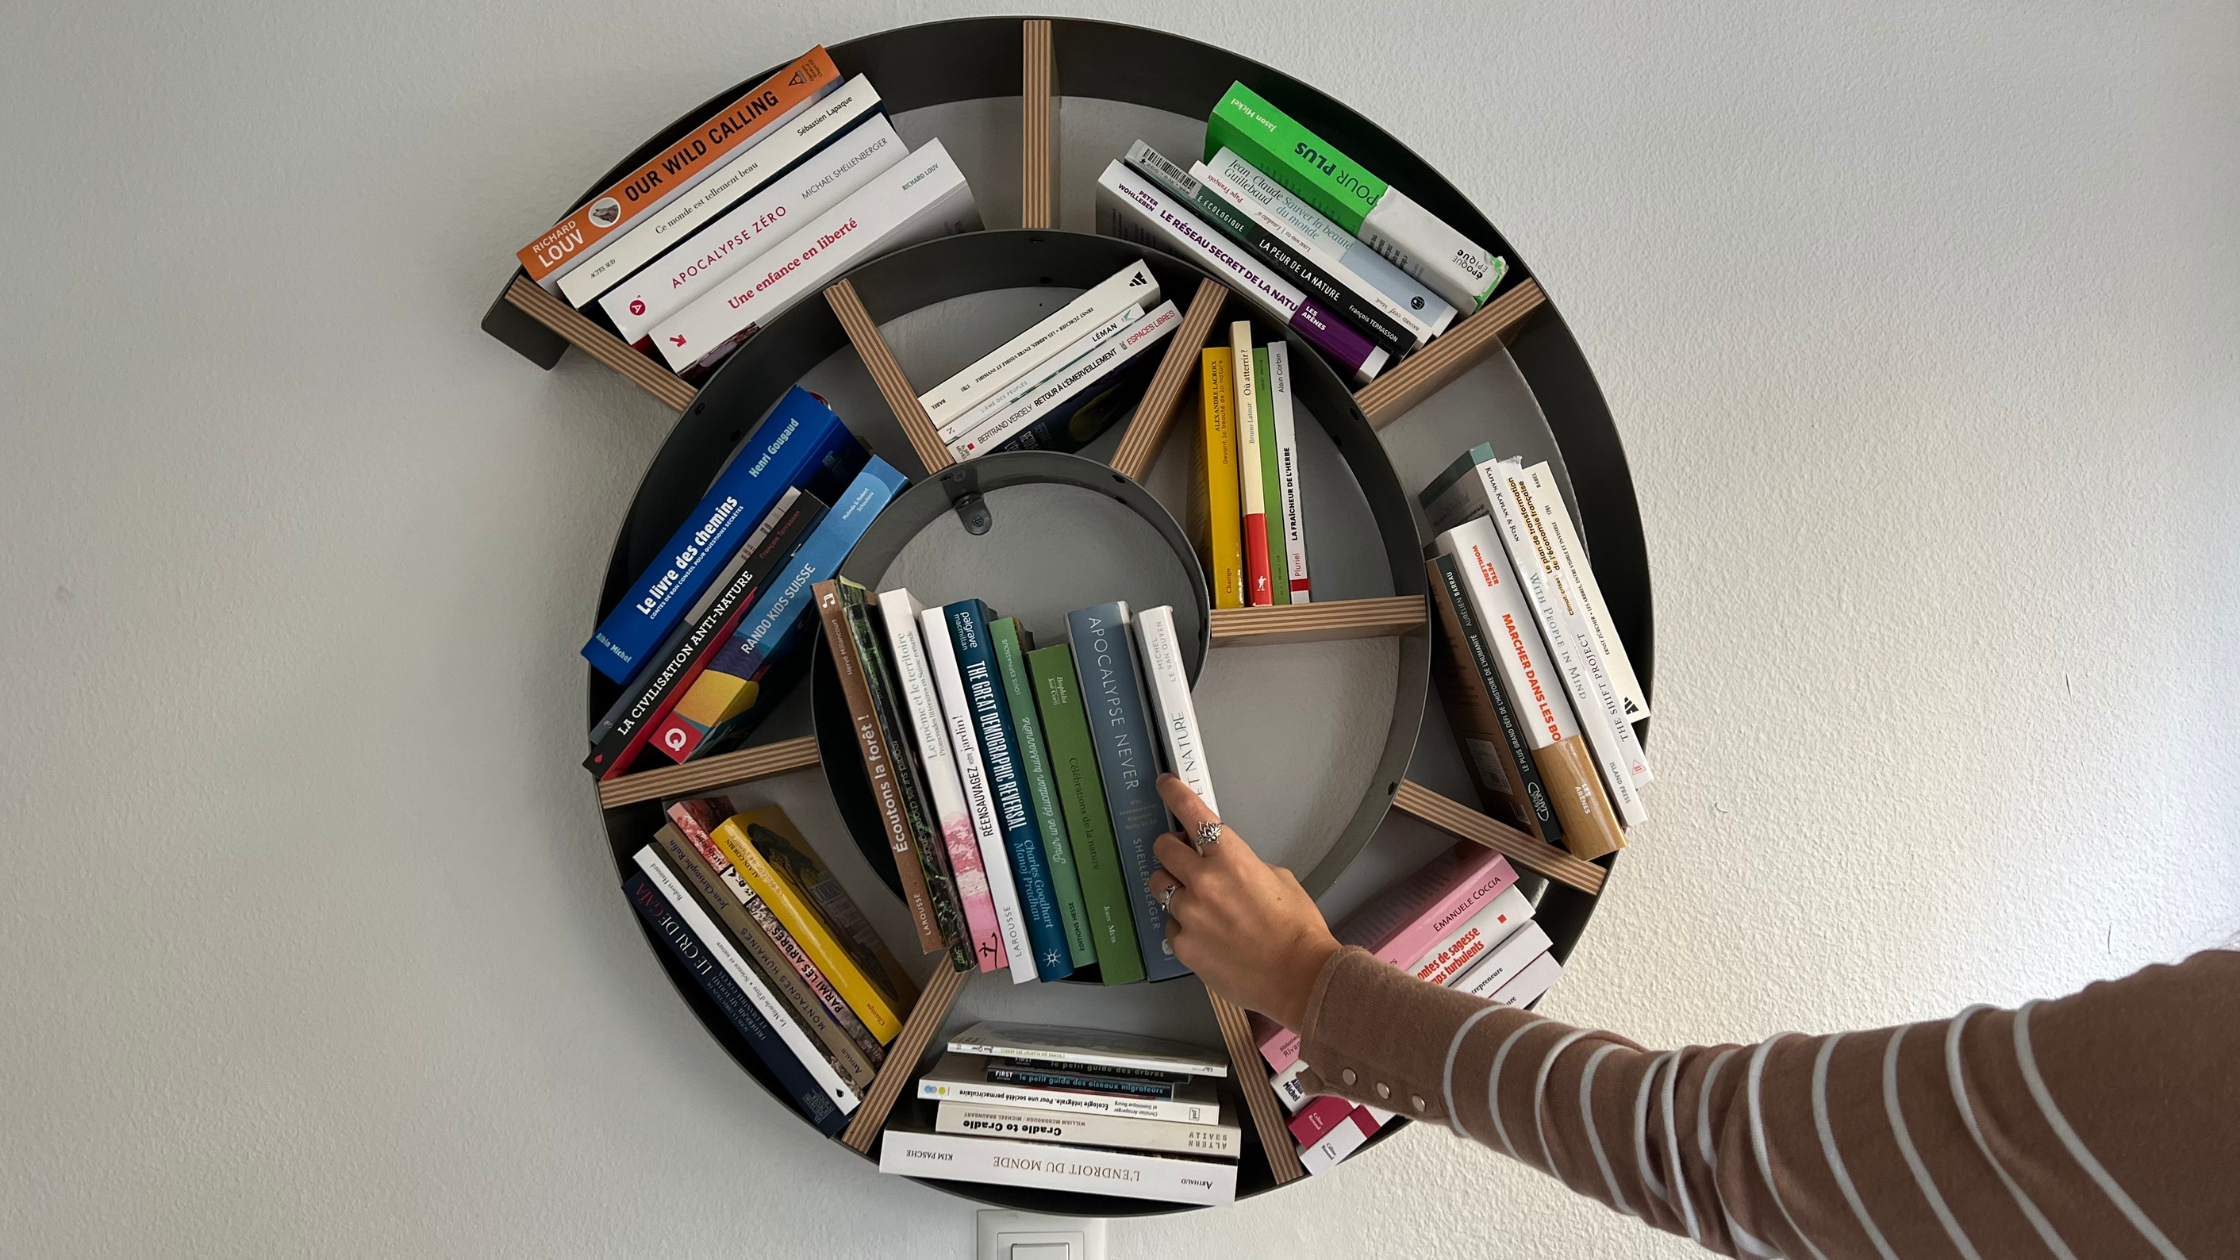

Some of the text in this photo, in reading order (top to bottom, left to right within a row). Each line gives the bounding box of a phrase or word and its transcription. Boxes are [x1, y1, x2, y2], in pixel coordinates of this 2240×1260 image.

[796, 96, 853, 137] Sébastien Lapaque
[1230, 98, 1278, 133] Jason Hickel
[624, 90, 779, 202] OUR WILD CALLING
[1294, 141, 1337, 177] PLUS
[655, 162, 759, 234] Ce monde est tellement beau
[1224, 165, 1274, 206] Guillebaud
[1228, 159, 1284, 201] Jean-Claude
[1336, 169, 1380, 206] POUR
[532, 220, 576, 254] RICHARD
[1275, 206, 1320, 240] du monde
[1281, 196, 1356, 251] Sauver la beauté
[538, 228, 584, 268] LOUV
[672, 206, 787, 289] APOCALYPSE ZÉRO
[727, 217, 858, 309] Une enfance en liberté
[1159, 209, 1174, 223] LE
[1171, 218, 1211, 249] RÉSEAU
[1208, 244, 1247, 274] SECRET
[1243, 269, 1260, 285] DE
[1257, 279, 1271, 294] LA
[1258, 239, 1341, 302] LA PEUR DE LA NATURE
[1301, 311, 1327, 331] ARÈNES
[1305, 305, 1318, 318] LES
[1091, 322, 1118, 343] LÉMAN
[1275, 353, 1285, 393] Alain Corbin
[976, 420, 1009, 445] BERTRAND
[1006, 403, 1033, 424] VERGELY
[1033, 387, 1059, 407] RETOUR
[1211, 360, 1221, 432] ALEXANDRE LACROIX
[748, 417, 800, 478] Henri Gougaud
[1283, 447, 1298, 541] LA FRAÎCHEUR DE L'HERBE
[1507, 476, 1553, 575] Le plan de transformation
[636, 495, 738, 615] Le livre des chemins
[1292, 552, 1302, 577] Pluriel
[1486, 562, 1500, 585] PETER
[1225, 567, 1233, 594] Champs
[739, 562, 816, 655] RANDO KIDS SUISSE
[595, 632, 633, 663] Albin Michel
[953, 612, 968, 651] macmillan
[617, 570, 753, 736] LA CIVILISATION ANTI-NATURE
[1501, 613, 1532, 670] MARCHER
[1525, 669, 1546, 703] DANS
[1539, 702, 1555, 724] LES
[897, 633, 938, 760] Le poème et le territoire
[1087, 617, 1125, 727] APOCALYPSE
[1114, 733, 1141, 790] NEVER
[1576, 633, 1629, 743] THE SHIFT PROJECT
[860, 723, 882, 762] forêt
[966, 660, 1028, 832] THE GREAT DEMOGRAPHIC REVERSAL
[874, 764, 887, 780] la
[1021, 716, 1067, 865] Pour une éducation buissonnière
[1580, 783, 1592, 798] LES
[880, 781, 909, 853] Écoutons
[966, 765, 994, 838] RÉENSAUVAGEZ
[1574, 784, 1591, 815] ARÈNES
[669, 839, 686, 861] Rufin
[684, 858, 730, 910] Jean-Christophe
[1013, 842, 1045, 921] Manoj Pradhan
[1022, 839, 1054, 929] Charles Goodhart
[660, 916, 680, 936] DE
[675, 933, 699, 959] CRI
[1003, 906, 1022, 958] LAROUSSE
[693, 959, 713, 976] LE
[771, 924, 845, 1014] PARMI LES ARBRES
[1416, 927, 1481, 983] ontes de sagesse
[1443, 940, 1485, 976] turbulents
[740, 927, 826, 1031] MONTAGNES HUMAINES
[959, 1089, 1005, 1099] permacirculaire
[1018, 1072, 1165, 1094] le petit guide des oiseaux migrateurs
[1039, 1097, 1054, 1105] Pour
[1054, 1098, 1083, 1107] intégrale.
[1084, 1100, 1109, 1111] Écologie
[962, 1120, 1062, 1137] Cradle to Cradle
[906, 1149, 954, 1161] KIM PASCHE
[993, 1156, 1140, 1182] L'ENDROIT DU MONDE
